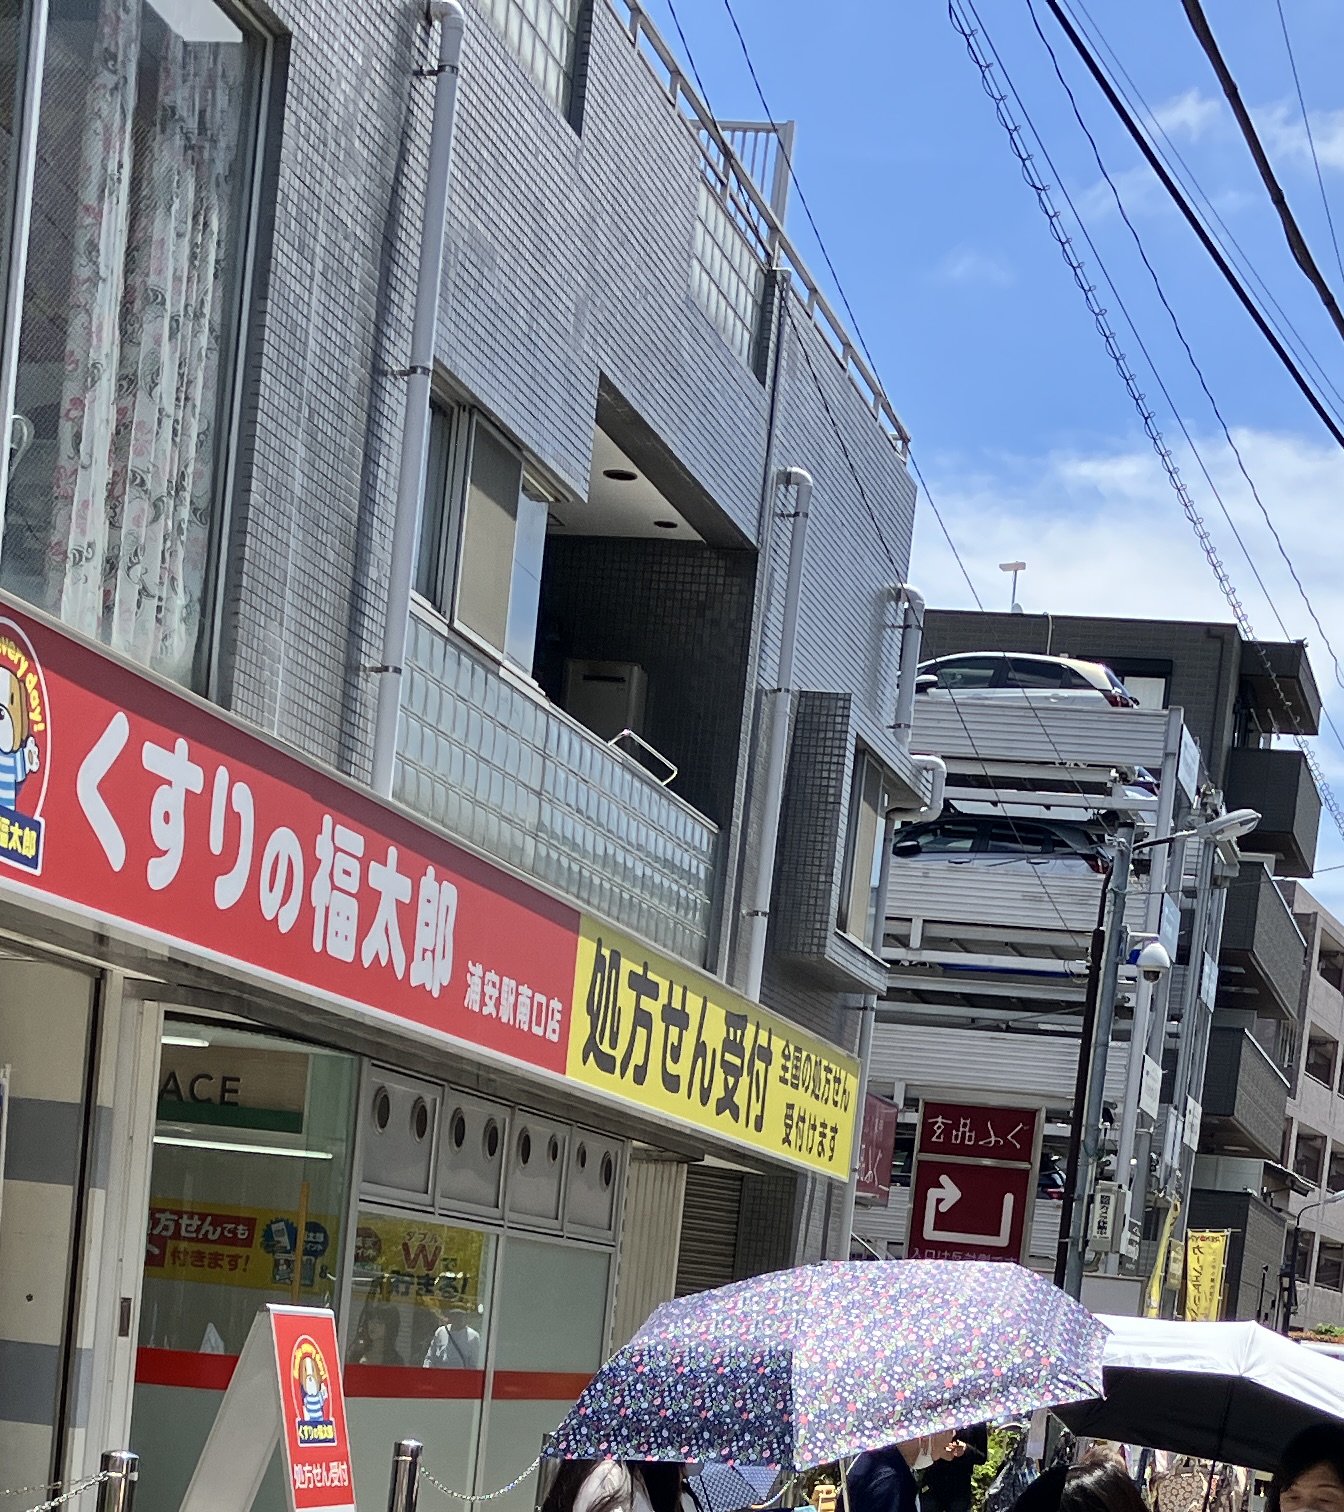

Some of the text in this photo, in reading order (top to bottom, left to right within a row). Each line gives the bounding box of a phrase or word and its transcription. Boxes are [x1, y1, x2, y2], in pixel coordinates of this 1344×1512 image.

[25, 672, 46, 733] day!
[75, 711, 458, 999] くすりの福太郎
[464, 960, 563, 1044] 浦安駅南口店
[582, 936, 773, 1133] 処方せん受付
[778, 1039, 851, 1114] 全国の処方せん
[782, 1102, 839, 1162] 受付けます
[927, 1114, 1030, 1150] 玄品ふぐ
[293, 1460, 349, 1490] 処方せん受付
